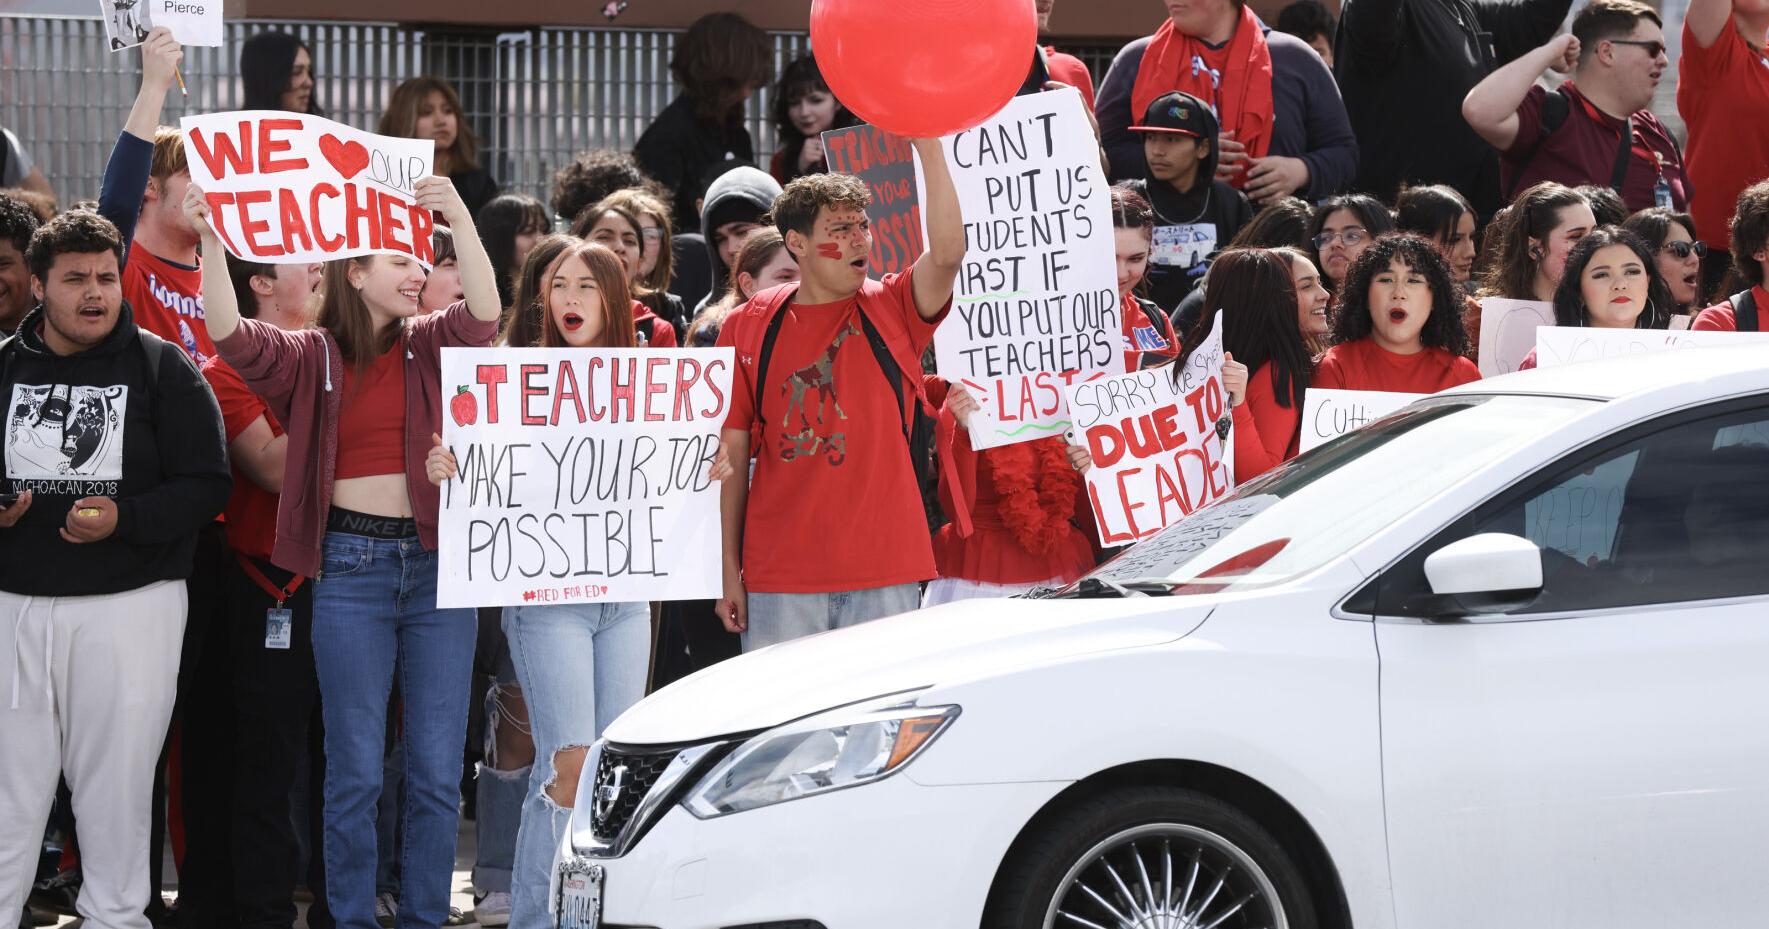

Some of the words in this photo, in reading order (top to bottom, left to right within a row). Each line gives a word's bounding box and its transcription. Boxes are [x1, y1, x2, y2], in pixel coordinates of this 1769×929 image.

[164, 1, 205, 16] Pierce
[189, 119, 309, 181] WE
[370, 148, 425, 192] OUR
[828, 127, 912, 174] TEACH
[953, 113, 1057, 168] CAN'T
[873, 178, 912, 207] YOUR
[985, 169, 1041, 215] PUT
[1055, 165, 1093, 205] US
[963, 204, 1093, 252] TUDENTS
[959, 256, 1026, 296] IRST
[1042, 250, 1070, 292] IF
[957, 301, 1012, 341] YOU
[1018, 295, 1067, 336] PUT
[1072, 288, 1117, 332] OUR
[959, 329, 1112, 378] TEACHERS
[476, 356, 726, 427] TEACHERS
[996, 371, 1081, 421] LAST
[1074, 372, 1156, 428] SORRY
[1085, 403, 1188, 468] DUE
[1184, 375, 1223, 435] TO
[12, 480, 83, 495] MICHOACAN
[86, 481, 118, 495] 2018
[446, 444, 531, 509] MAKE
[541, 435, 657, 509] YOUR
[657, 434, 721, 496] JOB
[1088, 430, 1230, 544] LEADE
[341, 513, 400, 536] NIKE
[468, 506, 668, 582] POSSIBLE
[563, 585, 581, 599] FOR
[585, 584, 600, 598] ED
